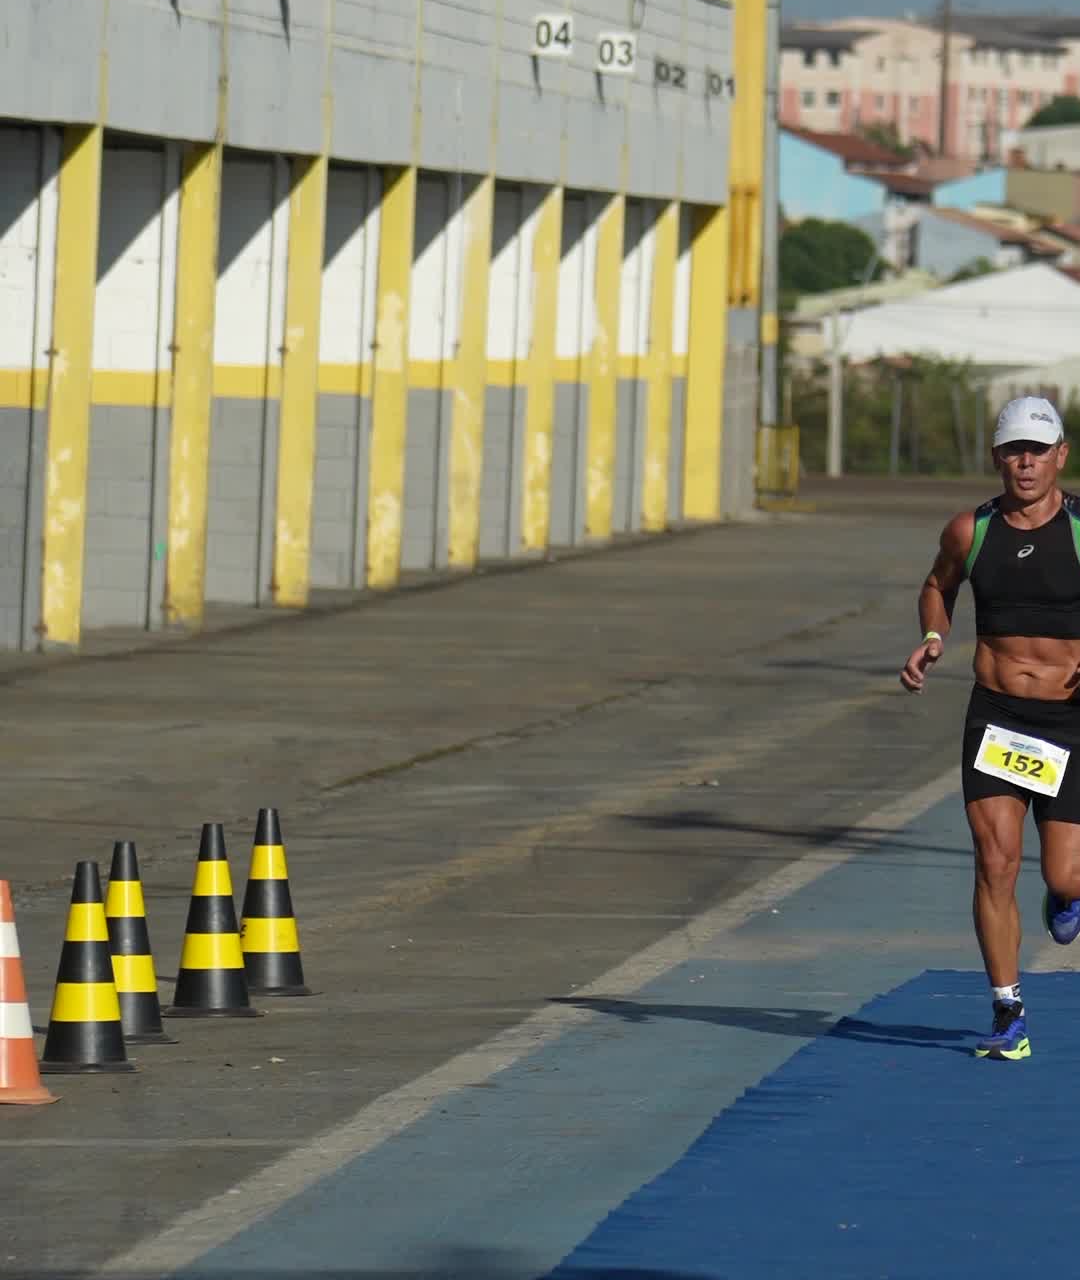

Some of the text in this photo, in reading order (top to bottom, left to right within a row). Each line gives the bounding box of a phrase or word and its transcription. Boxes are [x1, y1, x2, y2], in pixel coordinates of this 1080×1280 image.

[535, 20, 572, 48] 04
[599, 39, 633, 66] 03
[655, 61, 687, 89] 02
[1001, 751, 1045, 778] 152
